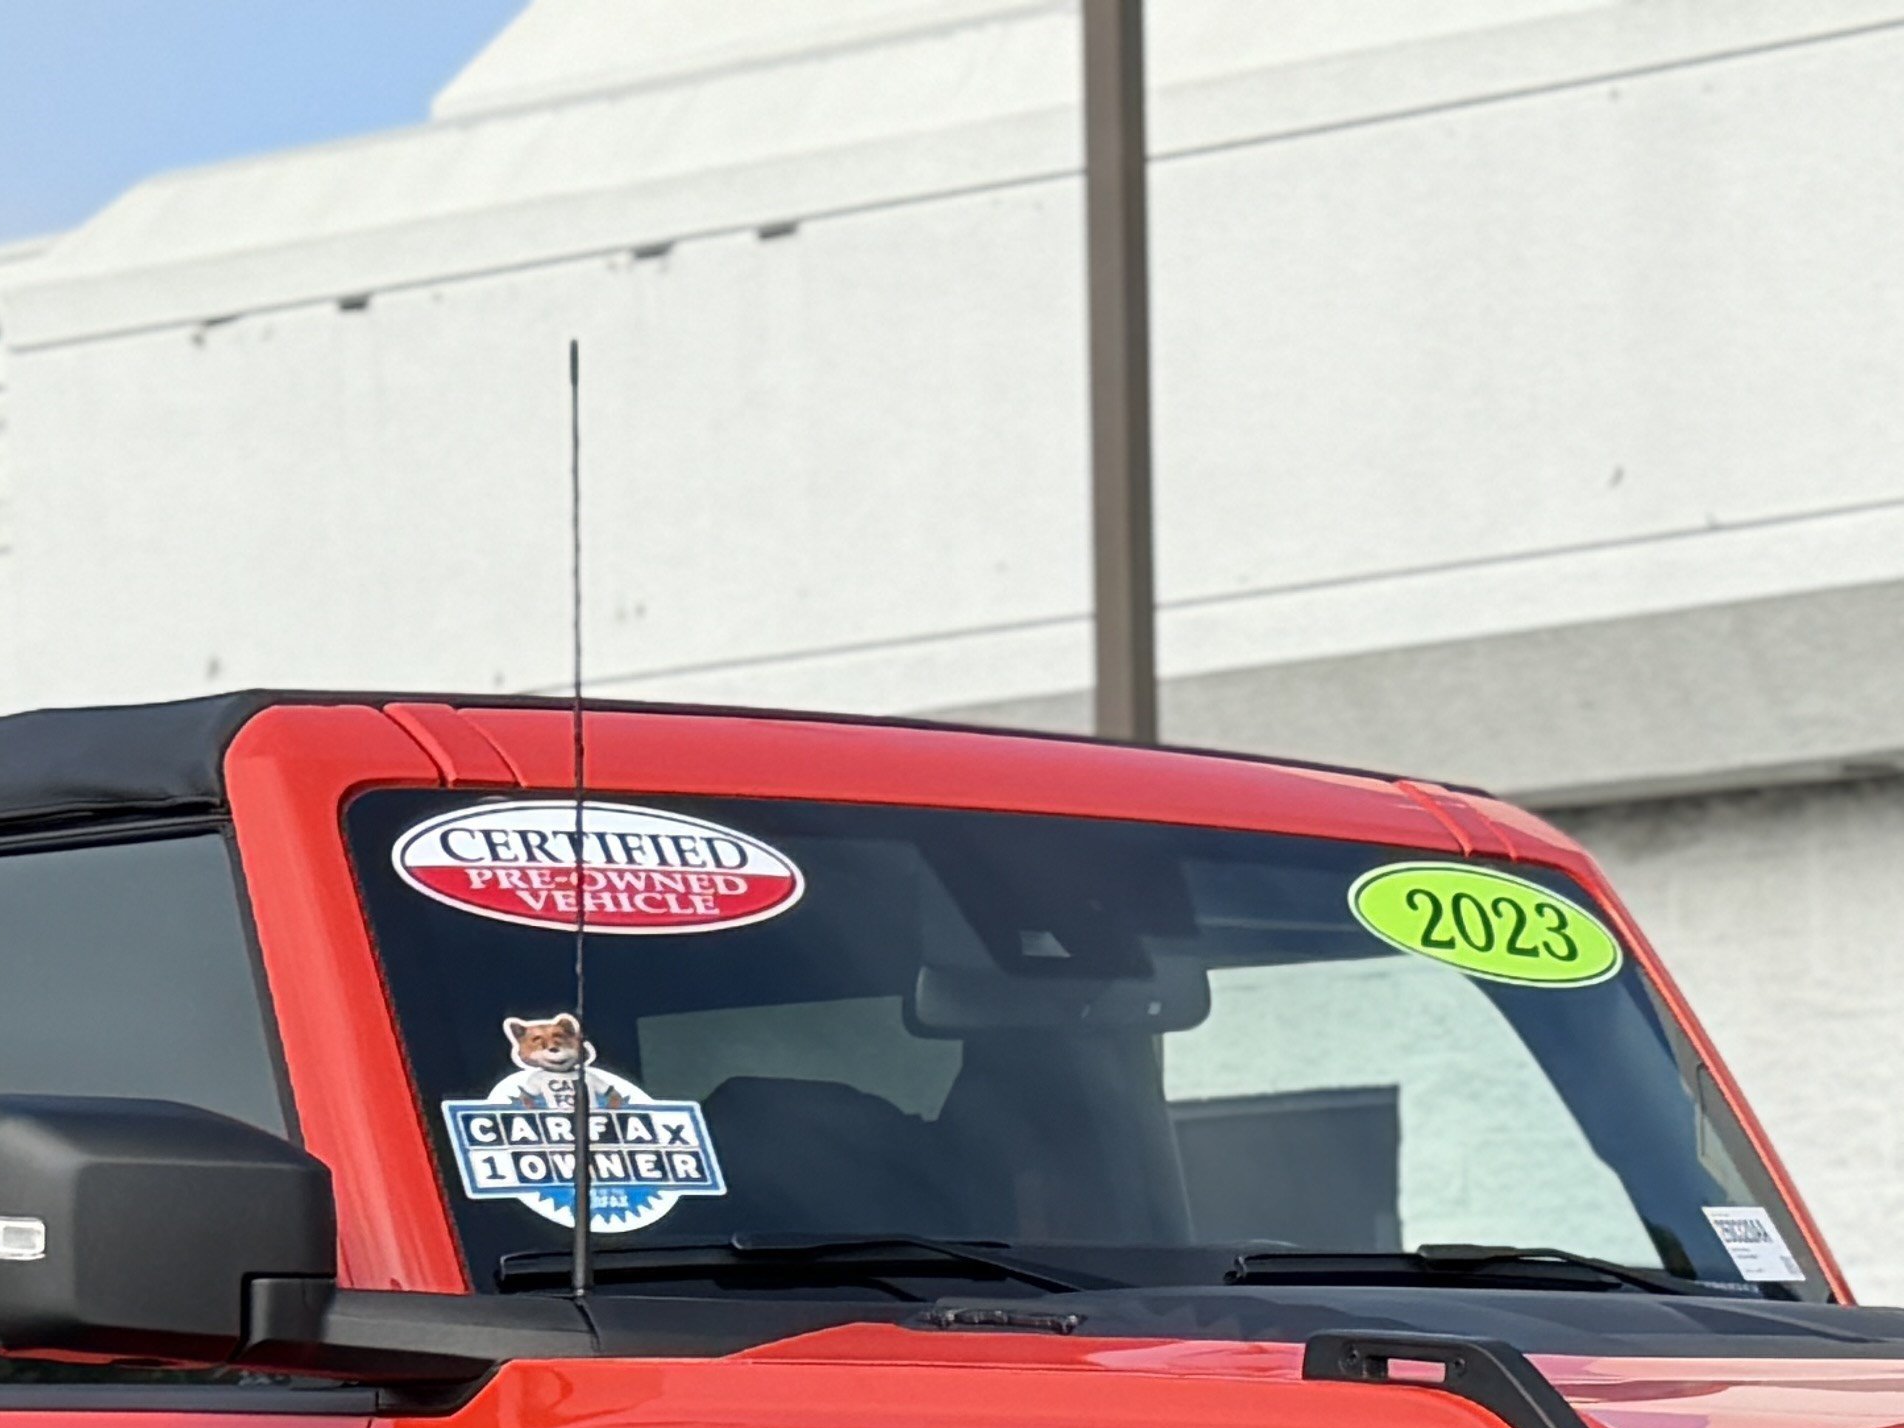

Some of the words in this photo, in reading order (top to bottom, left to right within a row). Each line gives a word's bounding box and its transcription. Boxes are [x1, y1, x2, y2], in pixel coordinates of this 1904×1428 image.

[439, 827, 749, 870] CERTIFIED
[464, 867, 749, 896] PRE-OWNED
[516, 889, 721, 915] VEHICLE
[1406, 888, 1579, 962] 2023
[469, 1115, 691, 1146] CARFAX
[481, 1155, 507, 1180] 1
[518, 1152, 702, 1181] OWNER
